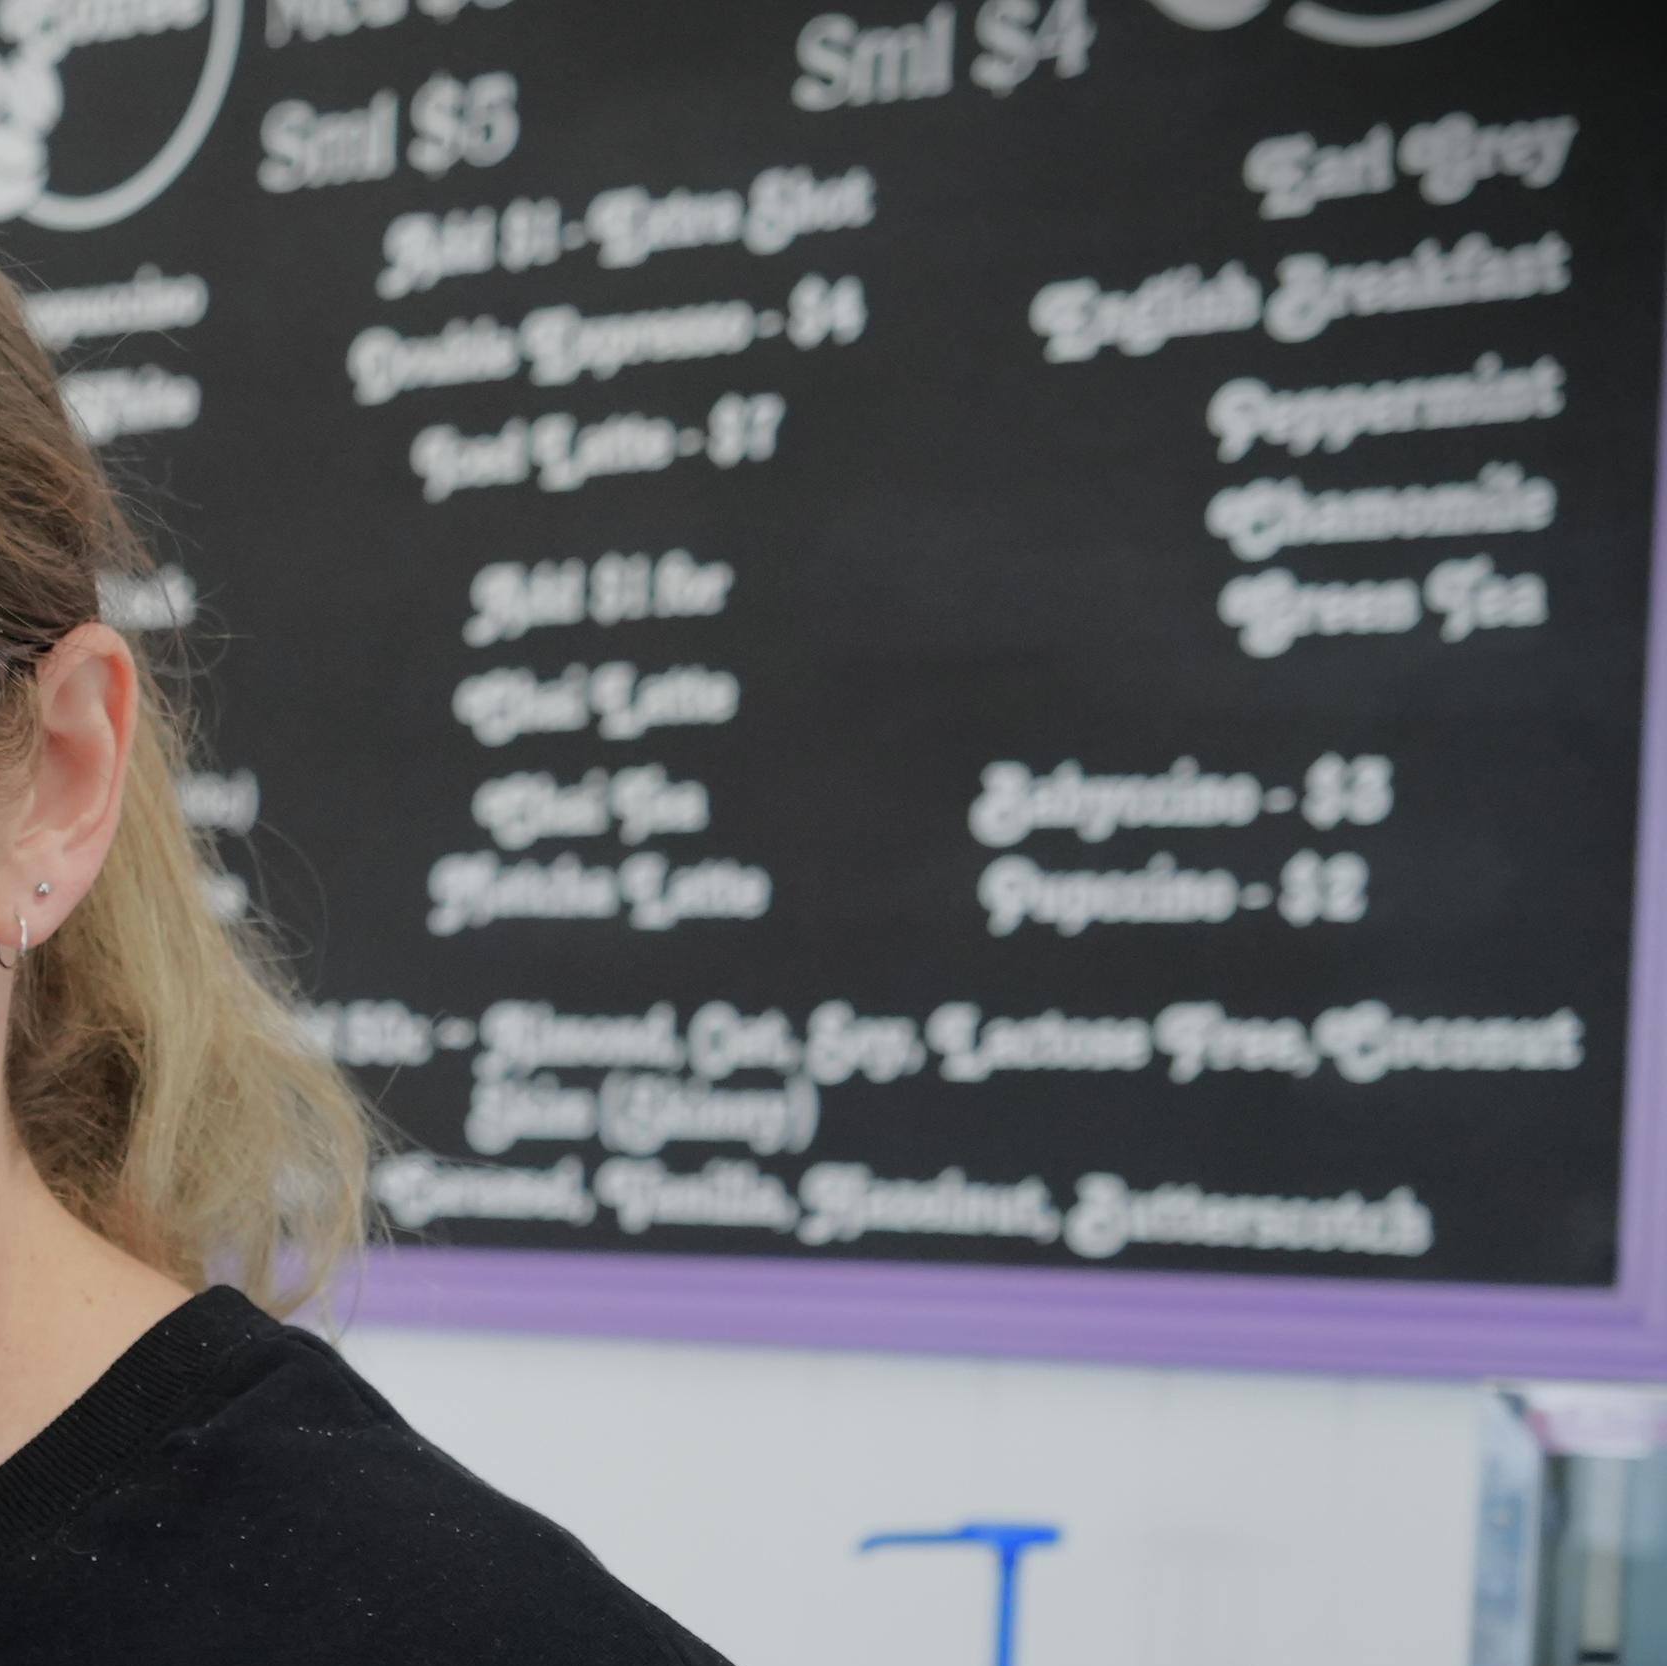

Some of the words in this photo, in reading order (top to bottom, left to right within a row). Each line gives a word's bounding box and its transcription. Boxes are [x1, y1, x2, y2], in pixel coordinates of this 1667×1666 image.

[792, 5, 955, 111] Sml
[971, 0, 1095, 94] $4
[259, 93, 397, 192] Sml
[408, 73, 519, 174] $5
[1243, 126, 1393, 219] Earl
[1397, 113, 1577, 205] Grey
[1029, 263, 1263, 363] English
[1263, 233, 1569, 343] Breakfast
[1206, 354, 1563, 462] Peppermint
[1205, 463, 1556, 568] Chamomile
[1218, 569, 1420, 658] Green
[1423, 555, 1546, 642] Tea
[589, 662, 738, 739] Latte
[617, 853, 771, 930] Latte
[926, 1003, 1154, 1082] Lactose
[1151, 1002, 1319, 1082] Free,
[1310, 1001, 1581, 1083] Coconut
[1059, 1173, 1432, 1258] Butterscotch
